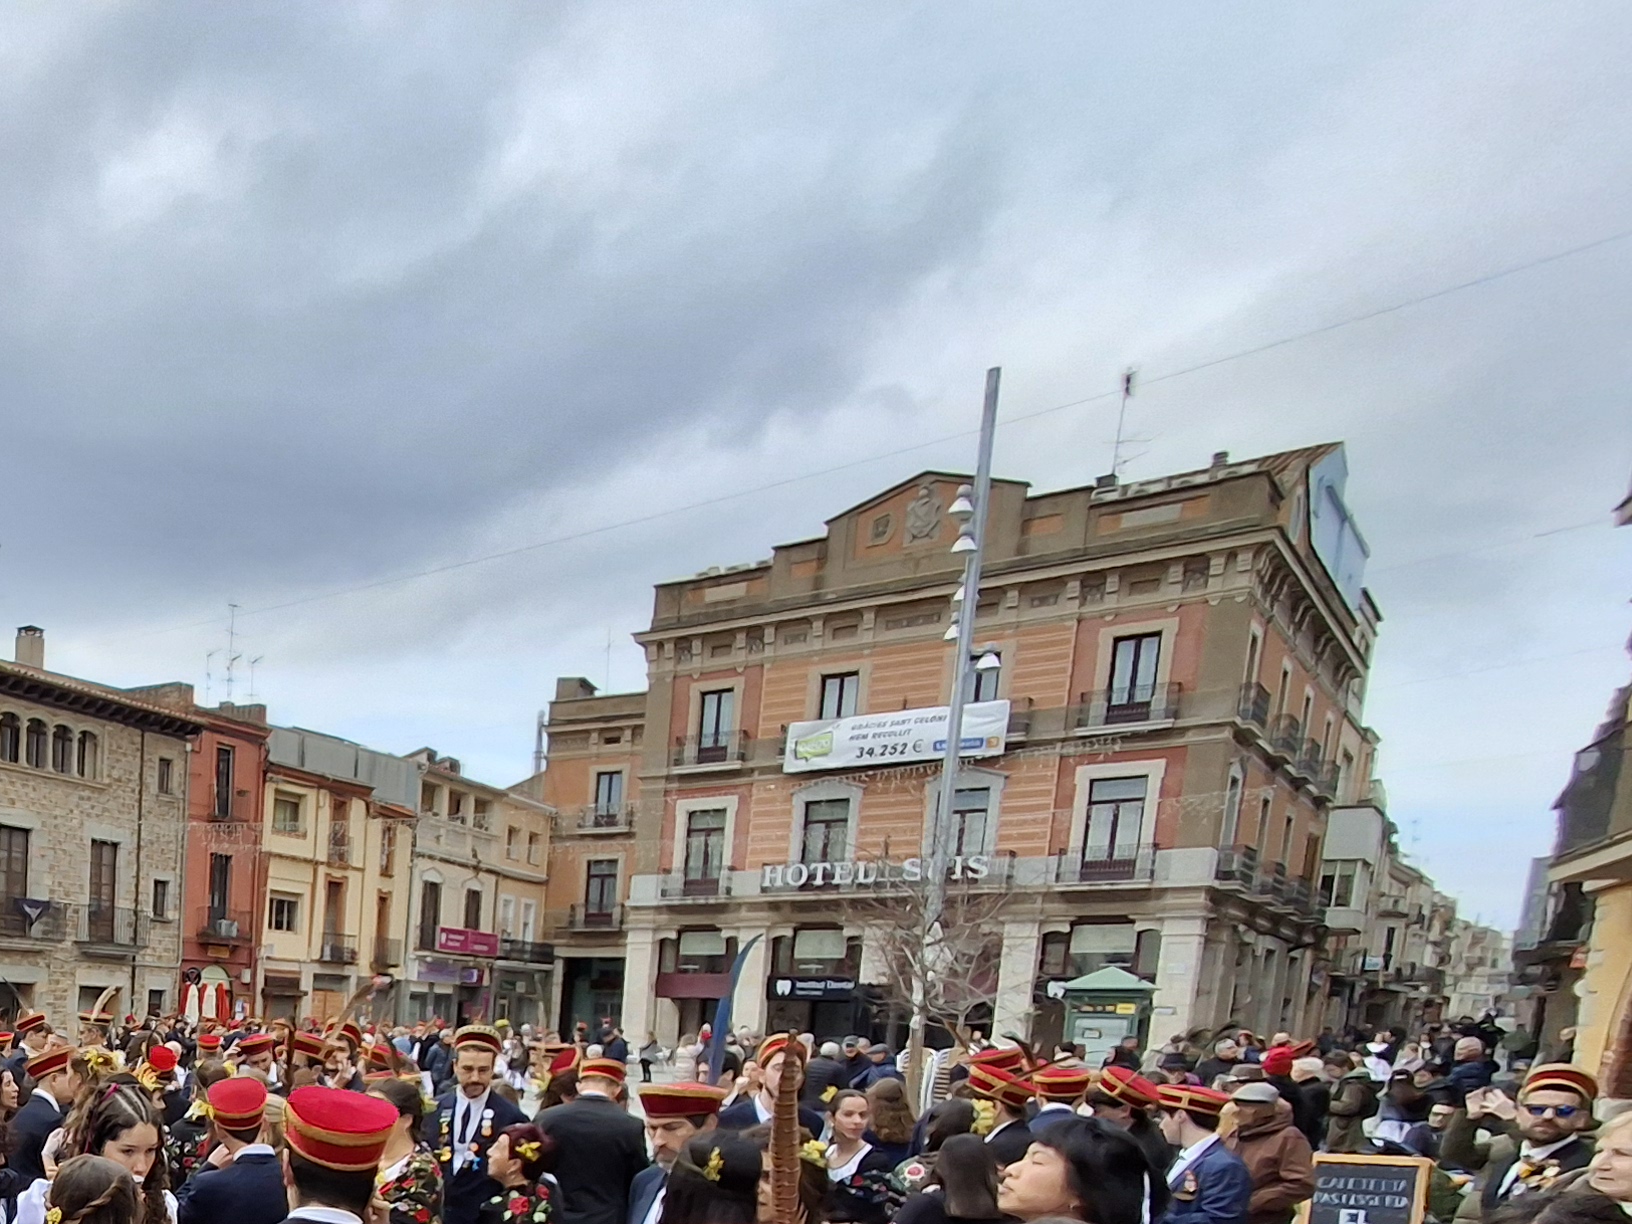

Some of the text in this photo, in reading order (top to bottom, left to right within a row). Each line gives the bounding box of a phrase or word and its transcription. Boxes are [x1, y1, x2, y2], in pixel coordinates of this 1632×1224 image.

[889, 717, 912, 727] SANT
[871, 728, 913, 739] RECOLLIT
[855, 742, 909, 758] 34.252
[761, 861, 878, 887] HOTEL
